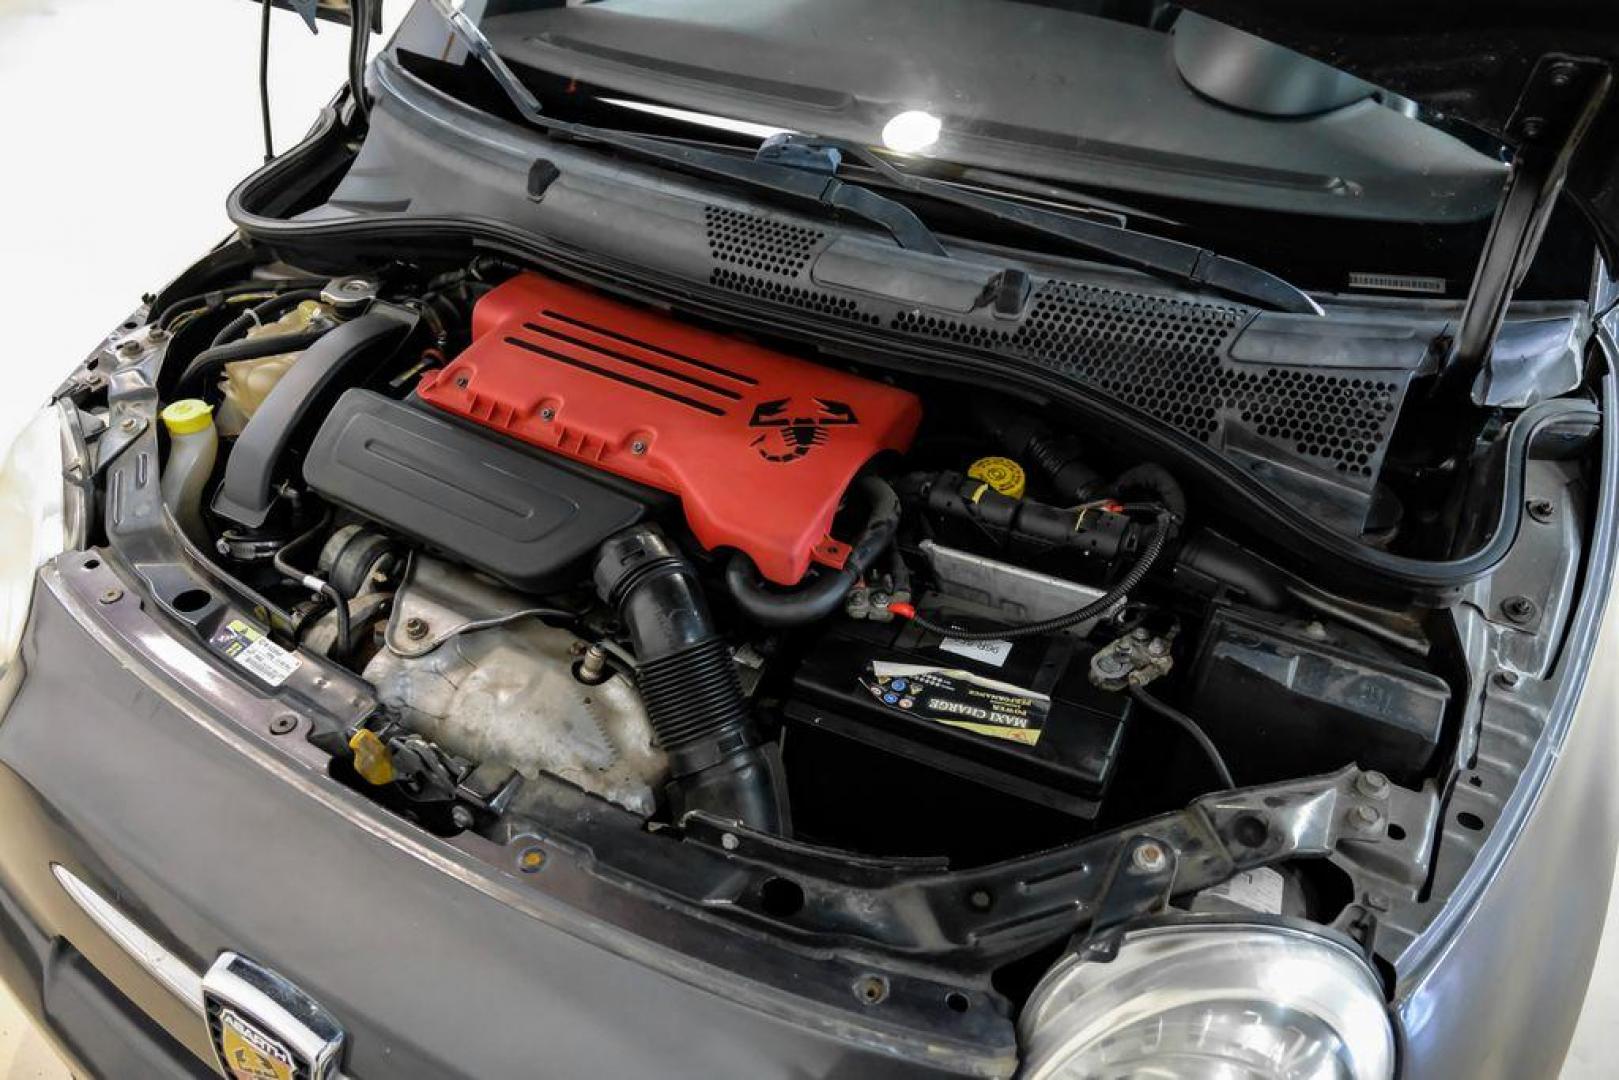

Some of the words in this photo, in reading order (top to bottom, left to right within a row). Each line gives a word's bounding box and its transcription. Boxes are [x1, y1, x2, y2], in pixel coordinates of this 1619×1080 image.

[928, 698, 987, 719] CHARGE
[989, 711, 1028, 729] MAXI
[223, 1013, 288, 1064] ABARTH
